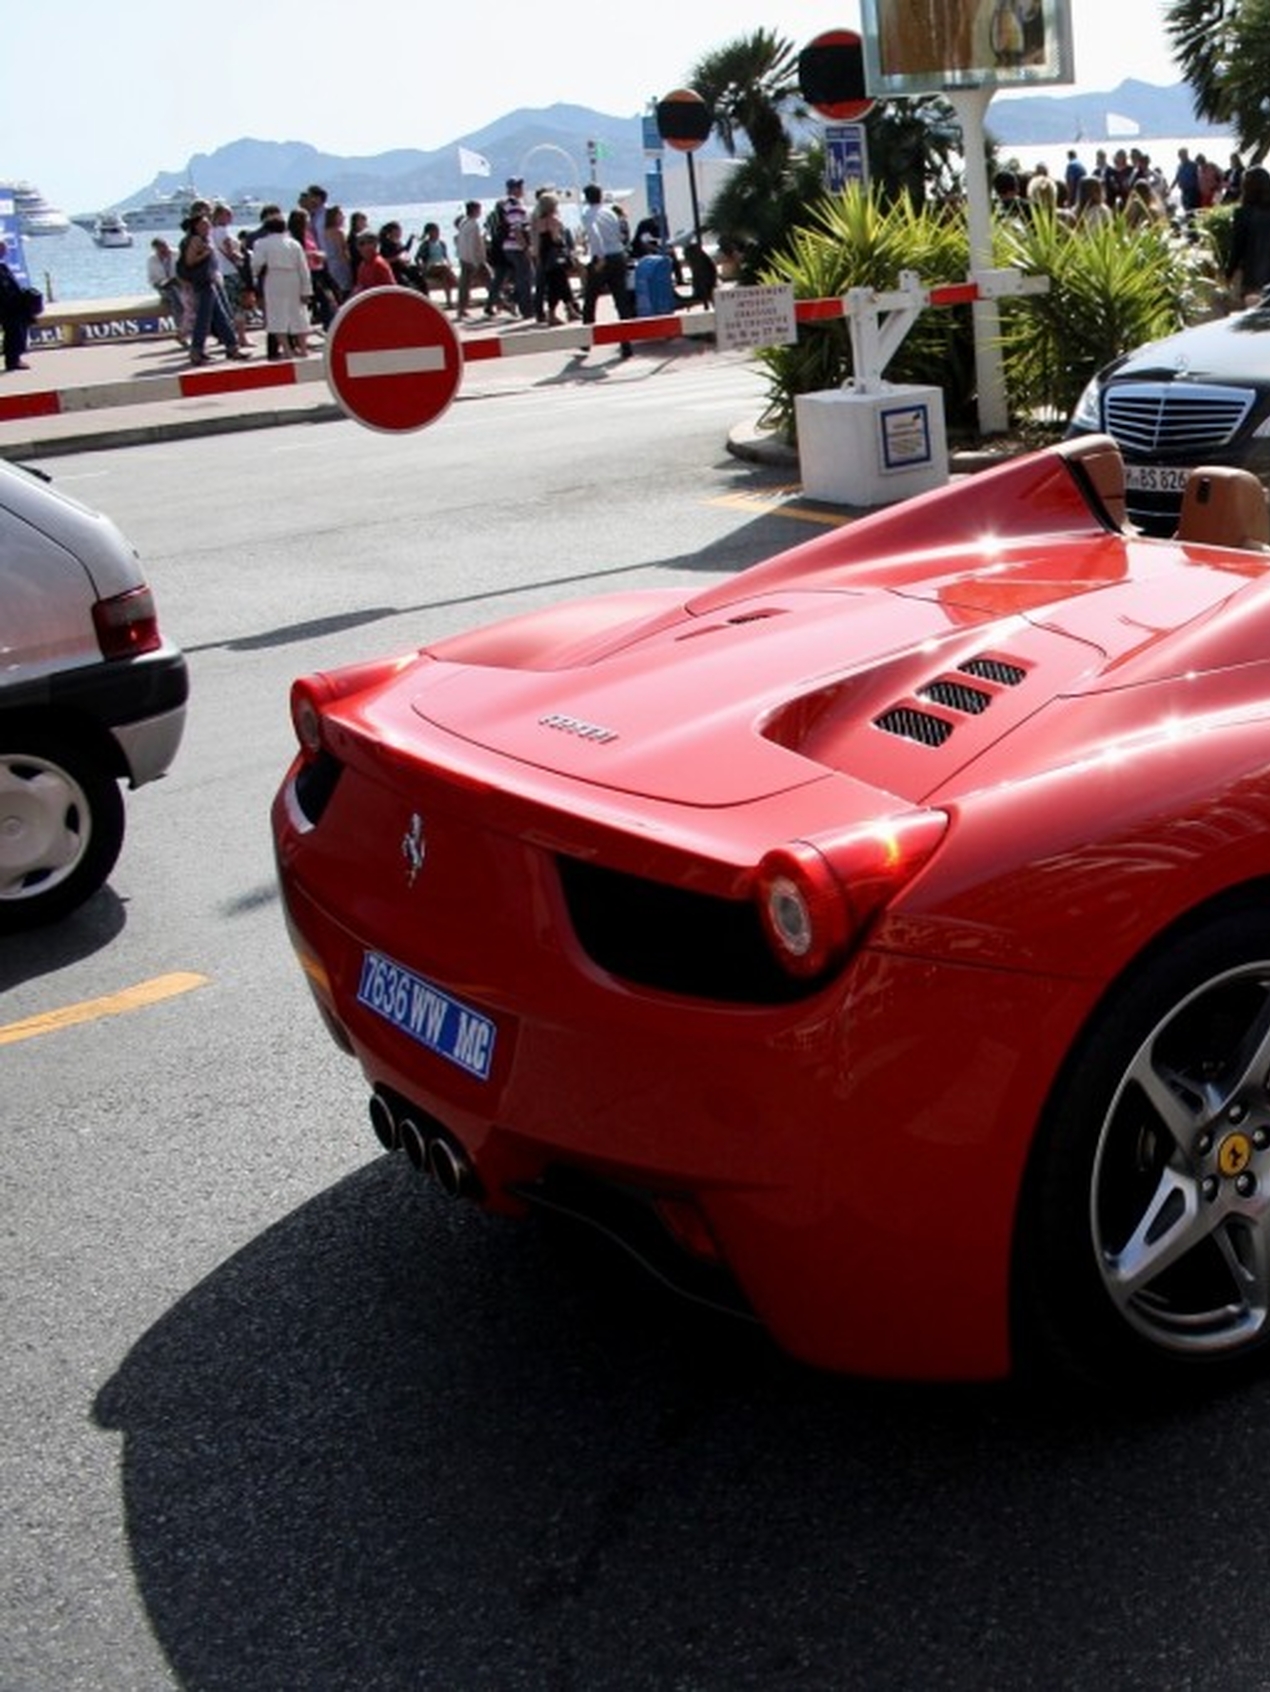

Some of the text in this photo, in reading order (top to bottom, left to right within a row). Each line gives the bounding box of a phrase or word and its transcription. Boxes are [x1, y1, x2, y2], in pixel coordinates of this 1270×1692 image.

[364, 955, 490, 1070] 7636 WW MC
